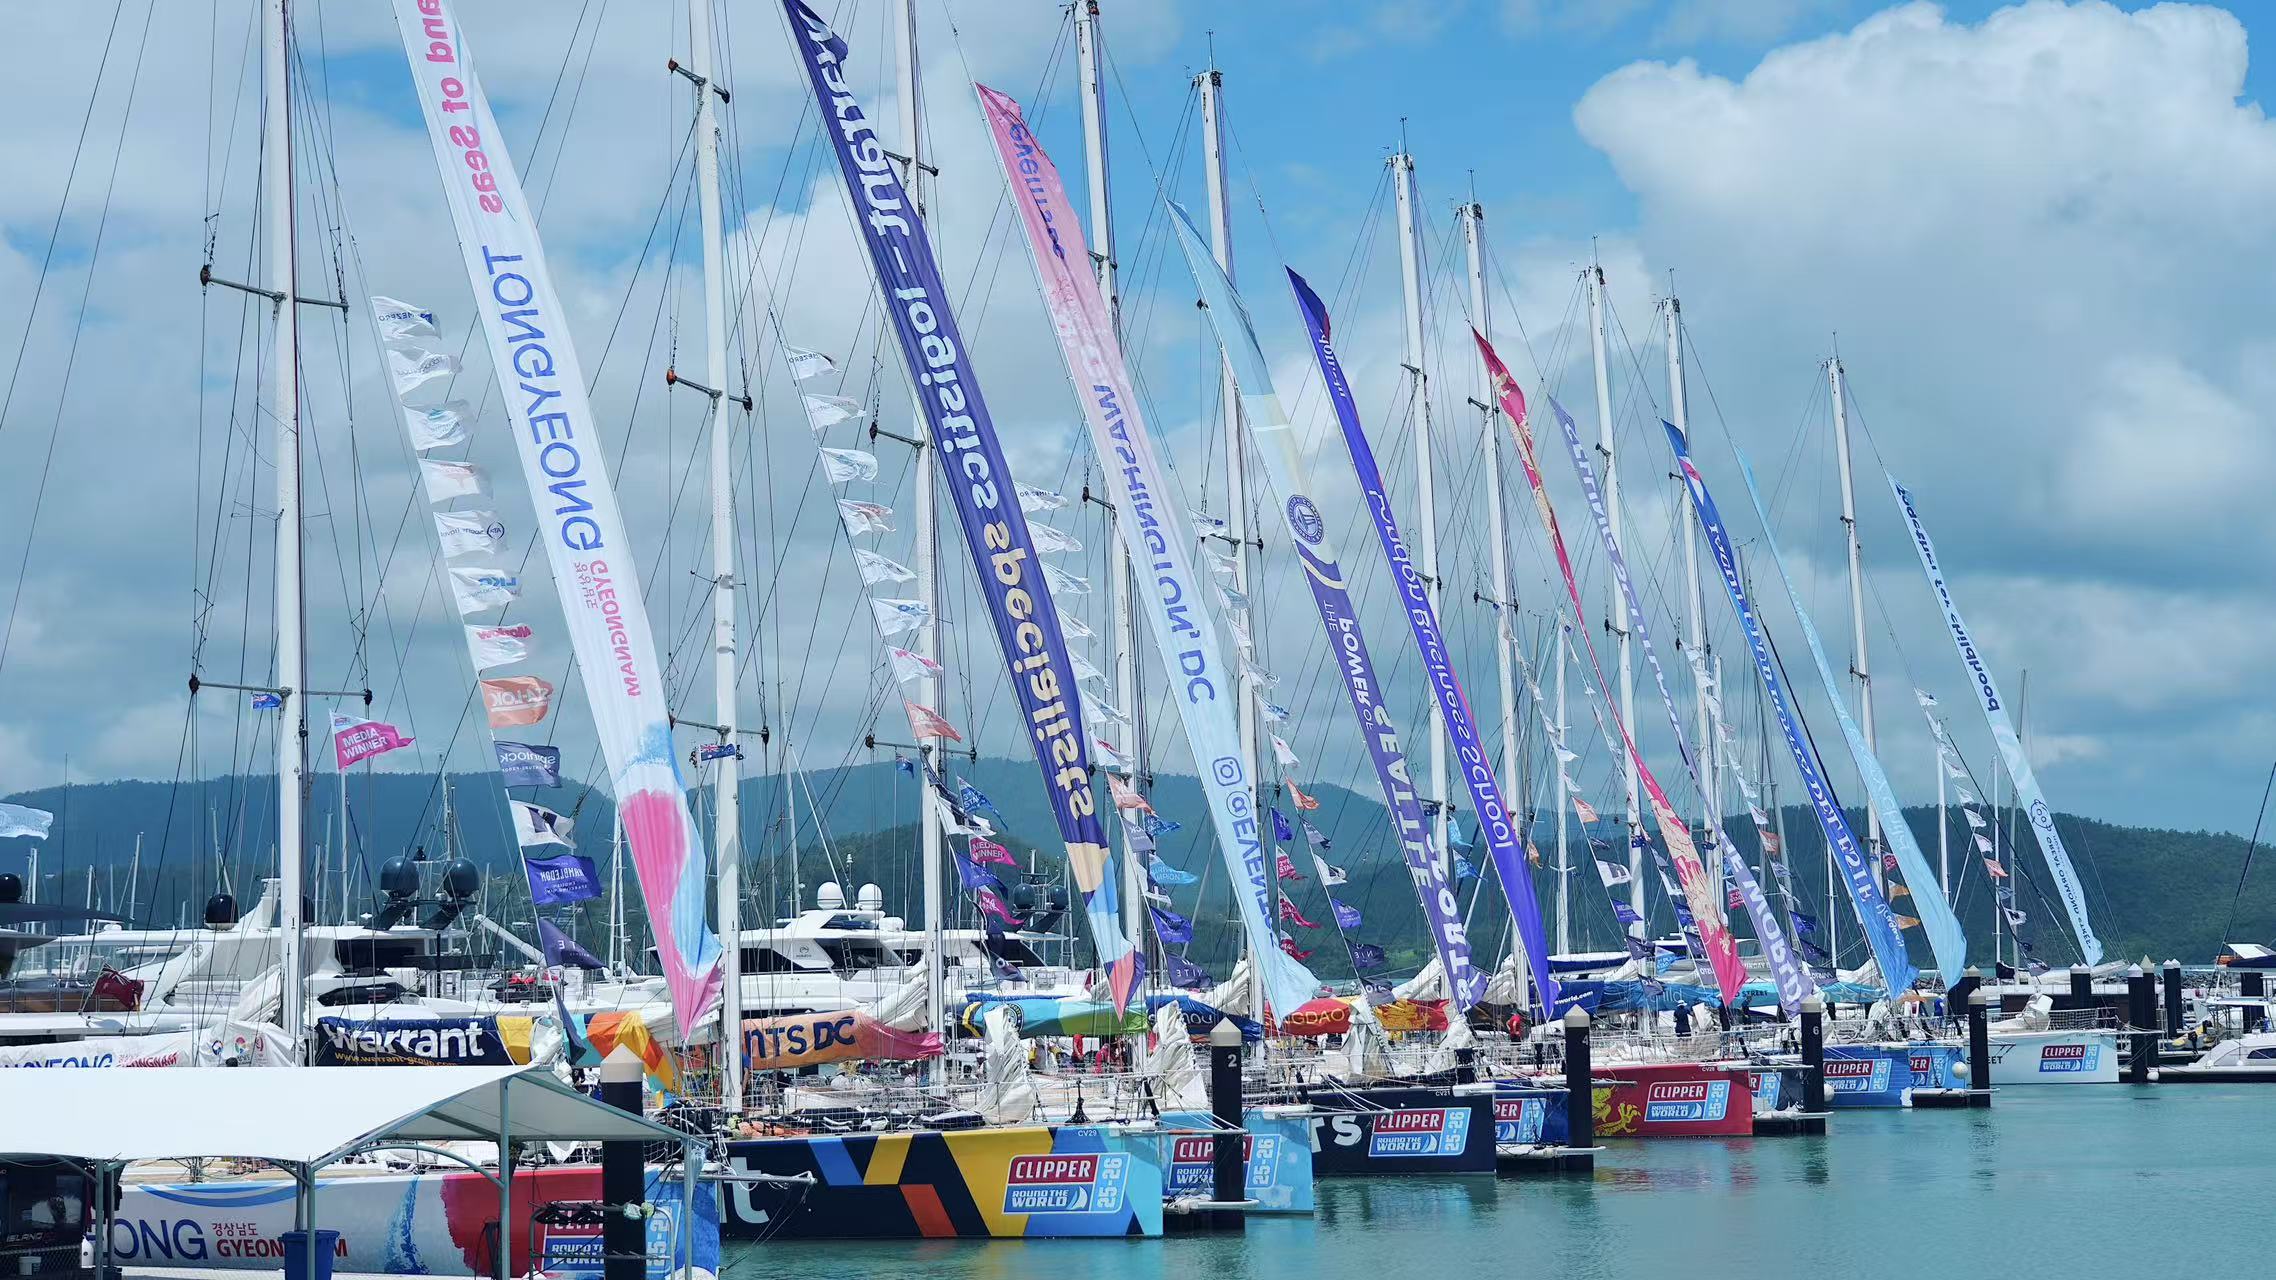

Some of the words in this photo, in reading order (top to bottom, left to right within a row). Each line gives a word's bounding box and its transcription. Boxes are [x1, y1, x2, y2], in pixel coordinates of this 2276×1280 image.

[342, 728, 379, 748] MEDIA
[342, 736, 388, 760] WINNER
[1812, 1026, 1820, 1035] 6
[322, 1021, 486, 1059] warrant
[2045, 1047, 2083, 1057] CLIPPER
[1227, 1054, 1238, 1068] 2
[1826, 1063, 1870, 1074] CLIPPER
[1653, 1085, 1704, 1098] CLIPPER
[1707, 1084, 1725, 1118] 25-26
[1651, 1109, 1688, 1117] WORLD
[1380, 1113, 1441, 1129] CLIPPER
[1077, 1129, 1097, 1137] CV29
[1445, 1111, 1464, 1151] 25-26
[1376, 1142, 1421, 1151] WORLD
[1253, 1138, 1275, 1185] 25-26
[1015, 1160, 1091, 1179] CLIPPER
[1097, 1157, 1123, 1208] 25-26
[1012, 1189, 1048, 1198] ROUND
[1049, 1189, 1069, 1197] THE
[1012, 1197, 1068, 1208] WORLD
[211, 1222, 259, 1236] 경상남도
